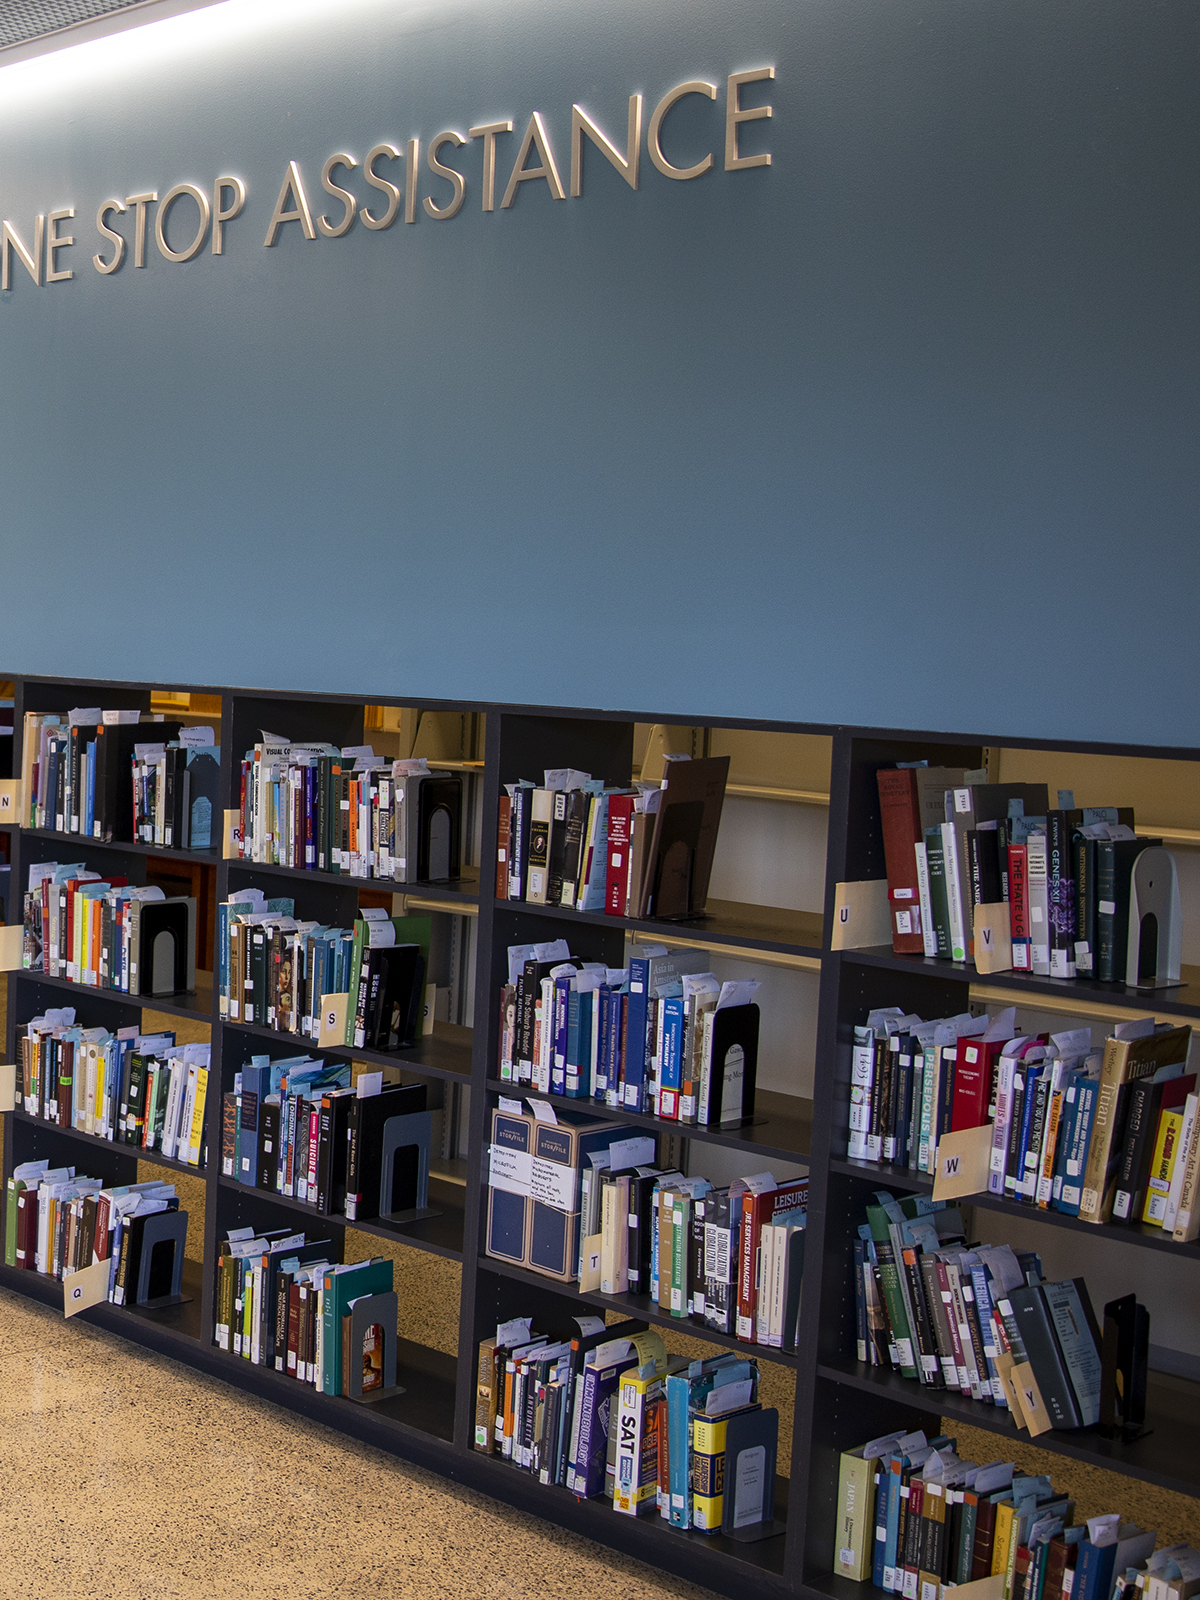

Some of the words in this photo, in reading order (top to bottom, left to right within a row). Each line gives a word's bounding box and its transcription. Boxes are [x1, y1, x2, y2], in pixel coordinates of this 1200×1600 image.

[92, 175, 247, 276] STOP
[263, 64, 778, 250] ASSISTANCE
[2, 798, 9, 807] N
[233, 829, 240, 839] R
[947, 858, 955, 875] Mercy
[1012, 859, 1023, 880] THE
[1051, 849, 1060, 887] GENES
[1013, 882, 1023, 911] HATE
[1051, 889, 1060, 903] XII
[840, 907, 848, 923] U
[1015, 914, 1024, 923] U
[983, 930, 991, 944] V
[653, 964, 666, 974] Asia
[667, 962, 675, 971] in
[524, 993, 532, 1005] The
[328, 1012, 336, 1025] S
[523, 1006, 531, 1030] Suburb
[522, 1031, 530, 1055] Reader
[857, 1053, 870, 1080] 1493
[1105, 1047, 1118, 1075] Wethey
[1127, 1059, 1156, 1080] Titian
[921, 1054, 934, 1132] PERSEPOLIS
[1013, 1089, 1021, 1115] BLURRED
[1097, 1082, 1116, 1126] Titian
[1035, 1106, 1043, 1117] YOU
[1050, 1112, 1058, 1132] SEASON
[1129, 1089, 1145, 1131] CHARGED
[287, 1105, 295, 1146] ORDINARY
[499, 1131, 525, 1143] STOR/FILE
[1010, 1116, 1019, 1154] BOUNDARIES
[1184, 1127, 1192, 1140] State
[309, 1138, 317, 1171] SUICIDE
[540, 1142, 567, 1155] STOR/FILE
[947, 1158, 959, 1174] W
[1045, 1154, 1053, 1172] PHILIP
[1188, 1159, 1197, 1170] Art
[1186, 1171, 1193, 1180] in
[1180, 1180, 1192, 1209] Canada
[705, 1227, 717, 1272] GLOBALIZATION
[743, 1224, 752, 1254] SERVICES
[590, 1255, 599, 1268] T
[716, 1232, 729, 1278] GLOBALIZATION
[741, 1254, 751, 1302] MANAGEMENT
[74, 1288, 81, 1298] Q
[972, 1270, 988, 1310] AMERICA
[980, 1311, 990, 1324] ON
[916, 1306, 924, 1322] World
[946, 1306, 958, 1333] Alchemical
[966, 1307, 975, 1320] THE
[950, 1333, 961, 1354] Mercury
[969, 1322, 981, 1353] MONTESI
[479, 1354, 487, 1384] MARTIN
[1026, 1391, 1035, 1407] Y
[524, 1395, 534, 1442] ANTOINETTE
[577, 1373, 596, 1467] IMMUNOBIOLOGY
[621, 1415, 636, 1454] SAT
[701, 1458, 710, 1493] LEADERSHIP
[846, 1481, 856, 1513] JAPAN
[1008, 1520, 1018, 1566] ENVIRONMENTAL
[925, 1545, 933, 1570] LITERATURE
[1005, 1567, 1014, 1589] ETHICS
[1079, 1574, 1088, 1589] THE
